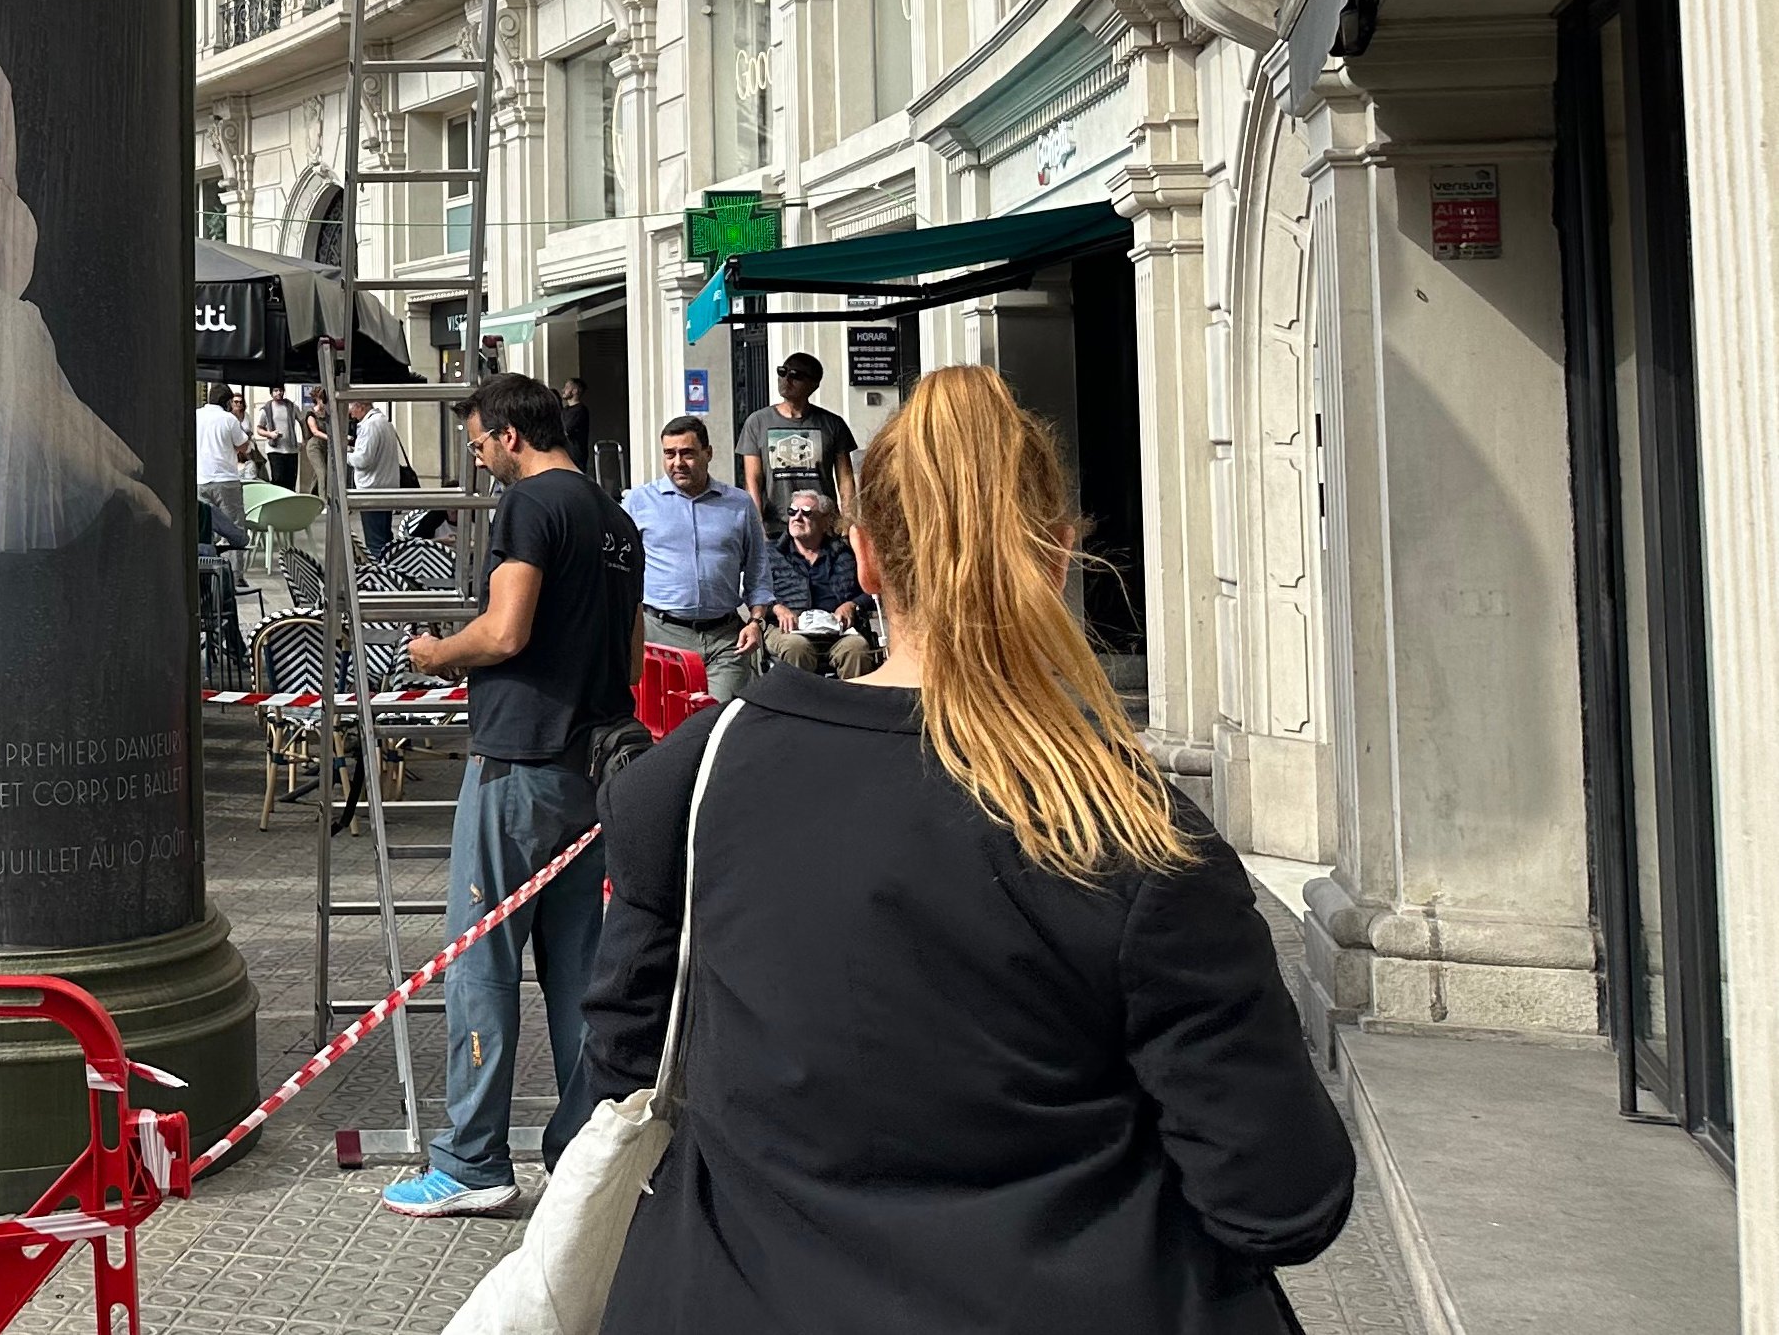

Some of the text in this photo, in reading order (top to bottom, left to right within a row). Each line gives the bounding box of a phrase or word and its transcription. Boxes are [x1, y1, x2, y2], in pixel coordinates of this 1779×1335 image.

[6, 739, 108, 767] PREMIERS
[116, 730, 182, 762] DANSEURS
[0, 767, 182, 808] ET CORPS DE BALLET
[89, 843, 115, 871] AU
[123, 839, 144, 865] 10
[150, 826, 185, 861] AOÛT
